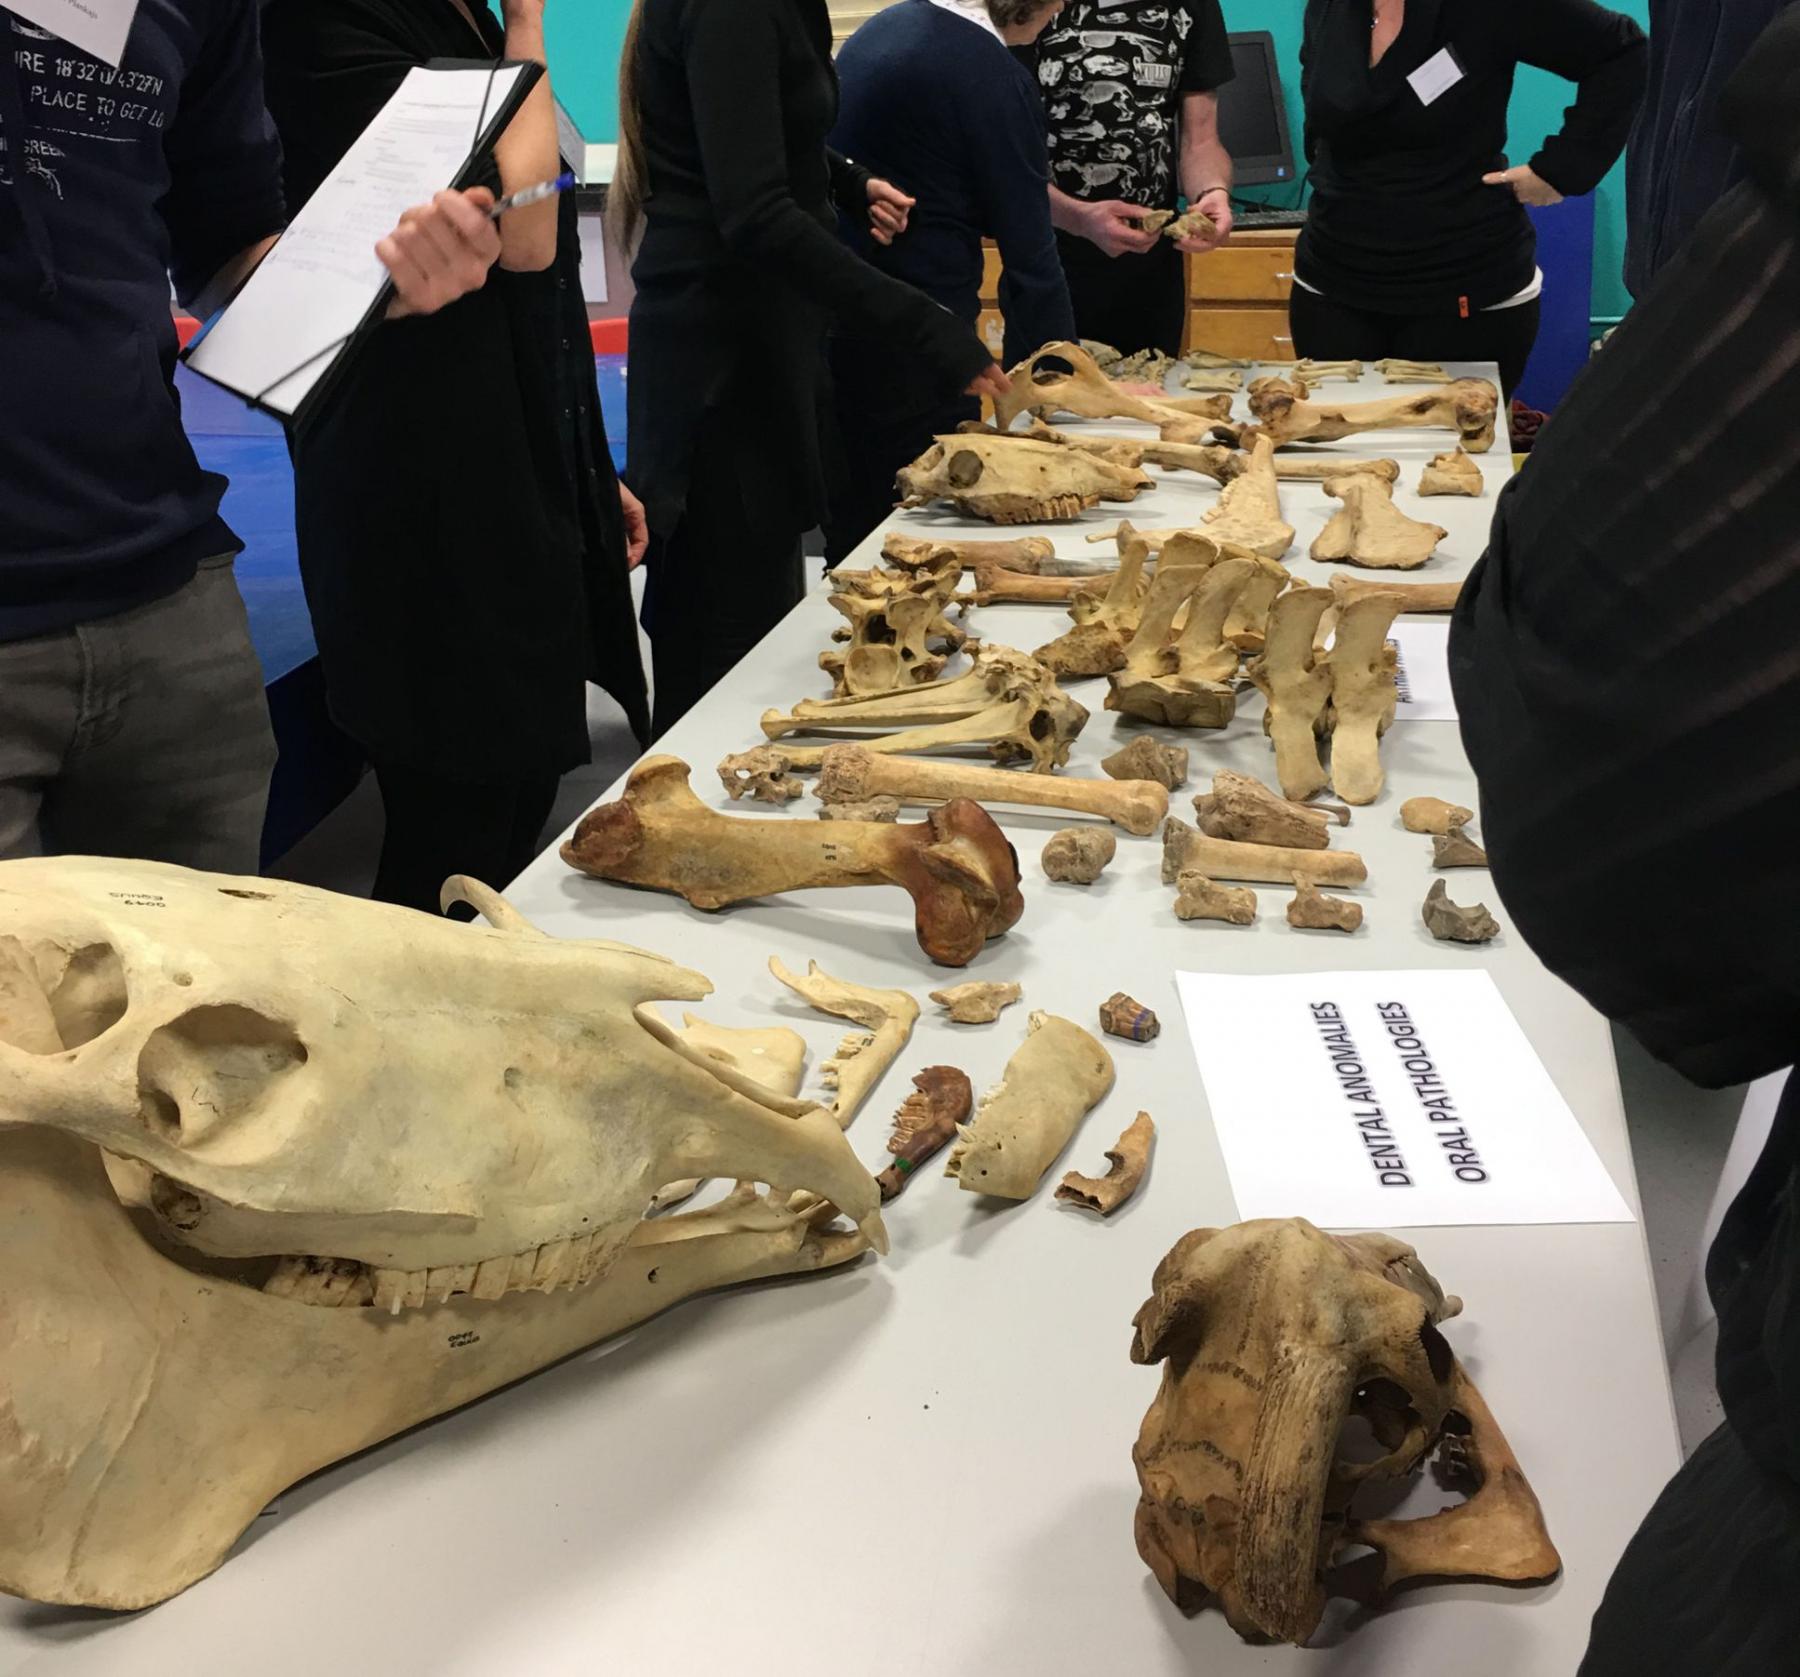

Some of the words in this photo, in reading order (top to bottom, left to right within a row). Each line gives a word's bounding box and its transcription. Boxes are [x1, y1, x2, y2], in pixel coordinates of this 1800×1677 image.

[31, 86, 88, 111] PLACE
[97, 97, 115, 116] TO
[119, 102, 148, 121] GET
[1310, 1001, 1377, 1103] ANOMALIES
[1377, 1001, 1460, 1123] PATHOLOGIES
[1354, 1107, 1411, 1187] DENTAL
[1437, 1127, 1488, 1184] ORAL
